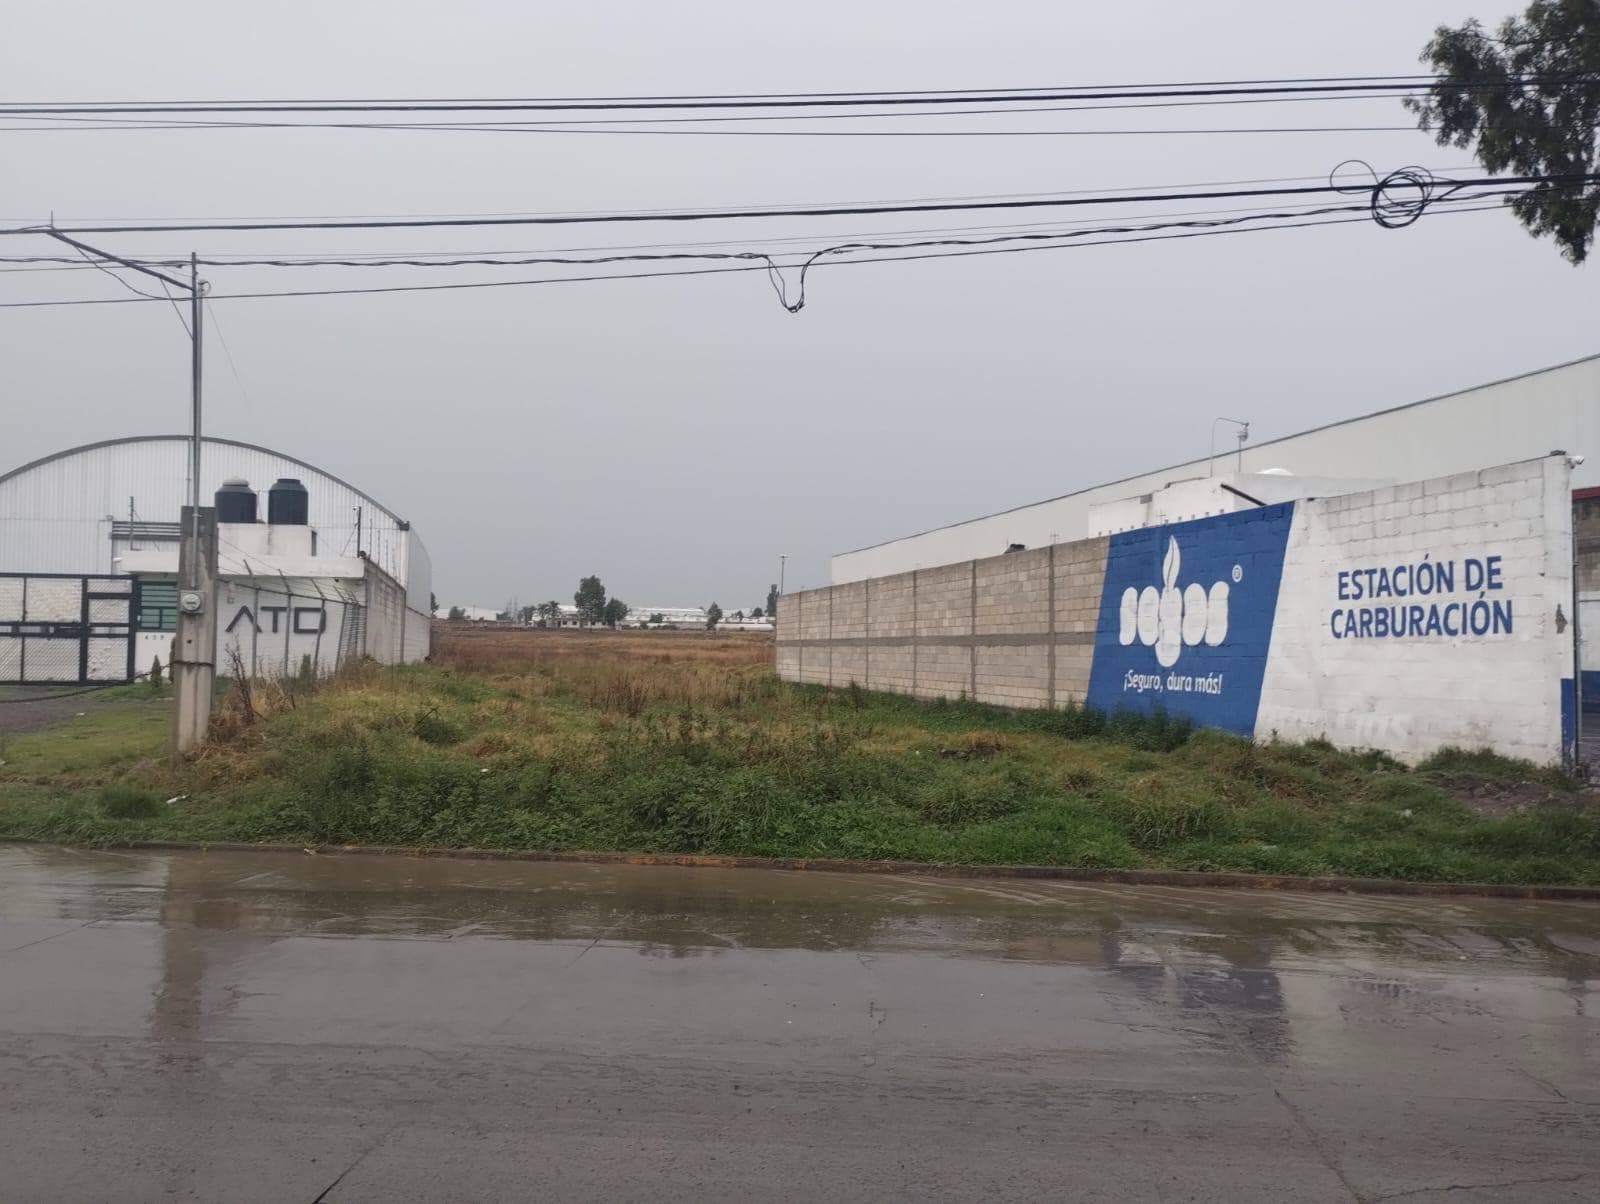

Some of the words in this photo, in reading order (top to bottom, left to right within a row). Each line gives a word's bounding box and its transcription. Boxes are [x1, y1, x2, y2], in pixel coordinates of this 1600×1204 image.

[1338, 553, 1454, 600] ESTACIÓN
[1464, 555, 1503, 591] DE
[1330, 591, 1513, 639] CARBURACIÓN
[1123, 669, 1164, 693] ¡Seguro,
[1166, 671, 1192, 692] dura
[1194, 672, 1223, 695] más!
